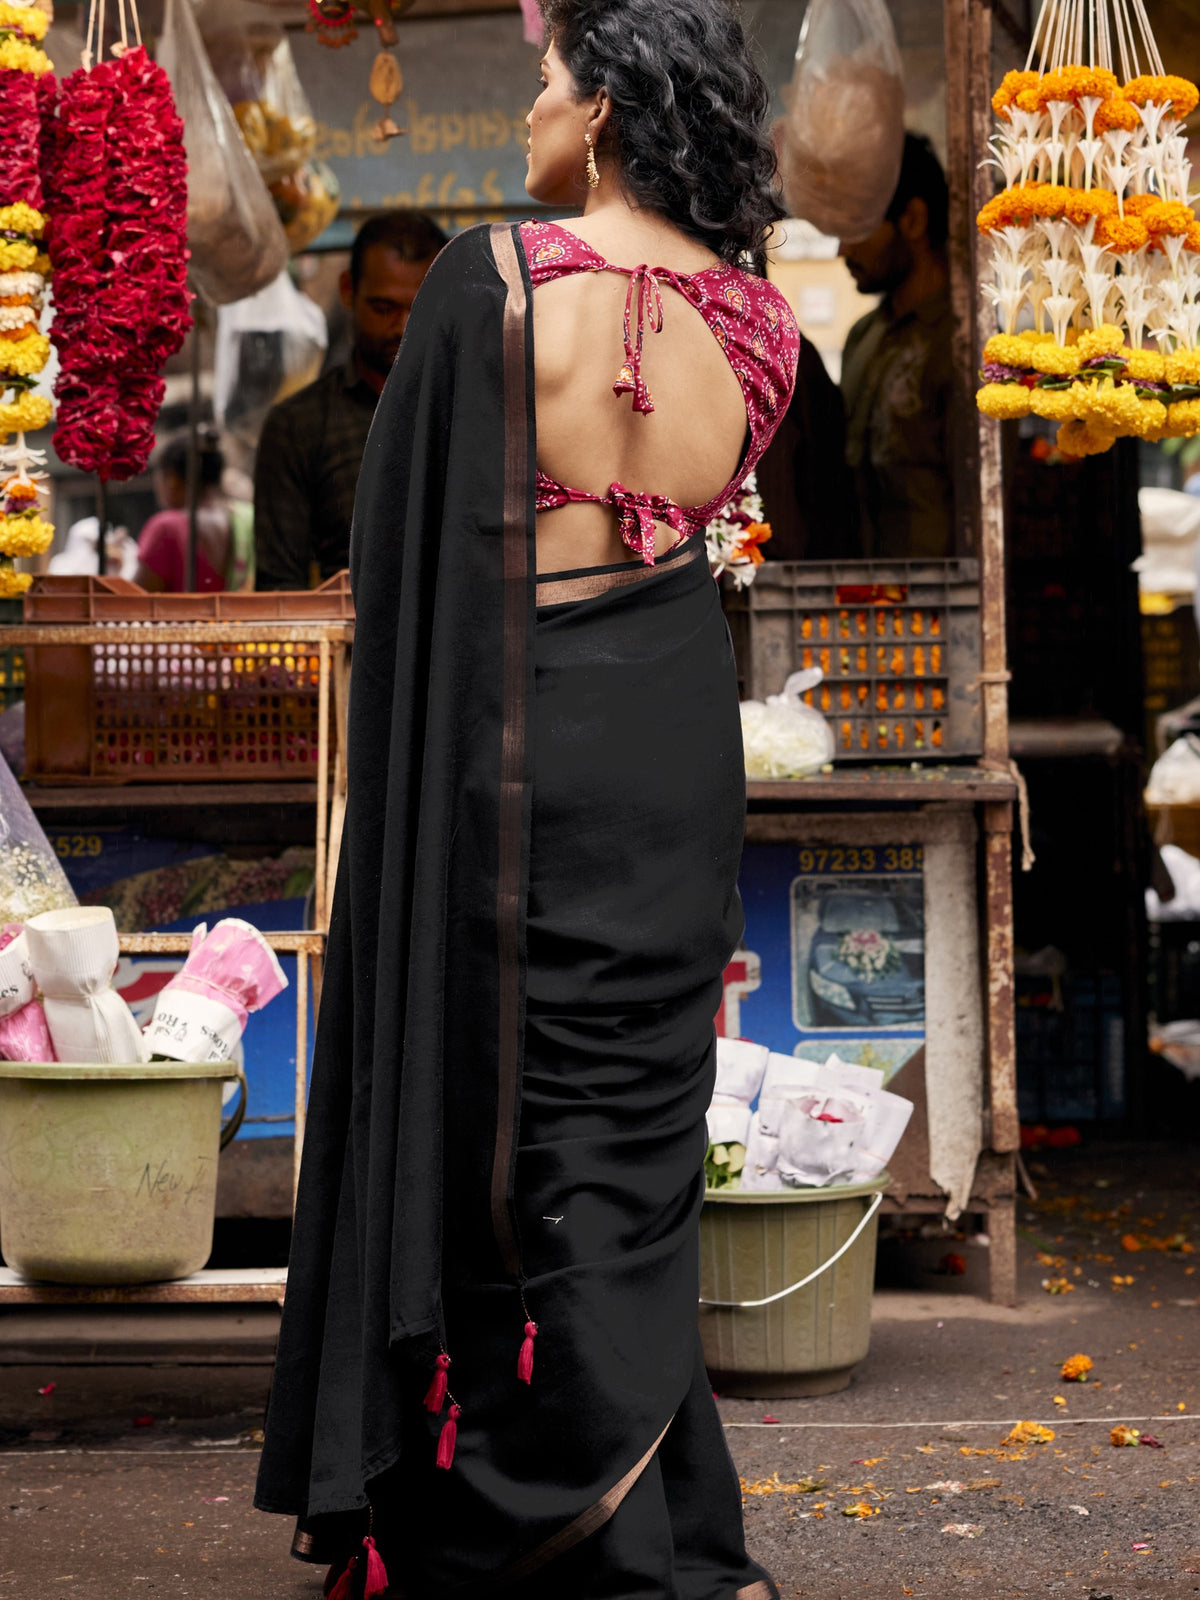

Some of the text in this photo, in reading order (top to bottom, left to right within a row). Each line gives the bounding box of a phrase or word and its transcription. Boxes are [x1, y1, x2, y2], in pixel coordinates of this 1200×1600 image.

[48, 835, 102, 858] 529
[798, 848, 876, 872] 97233
[135, 1159, 184, 1198] New
